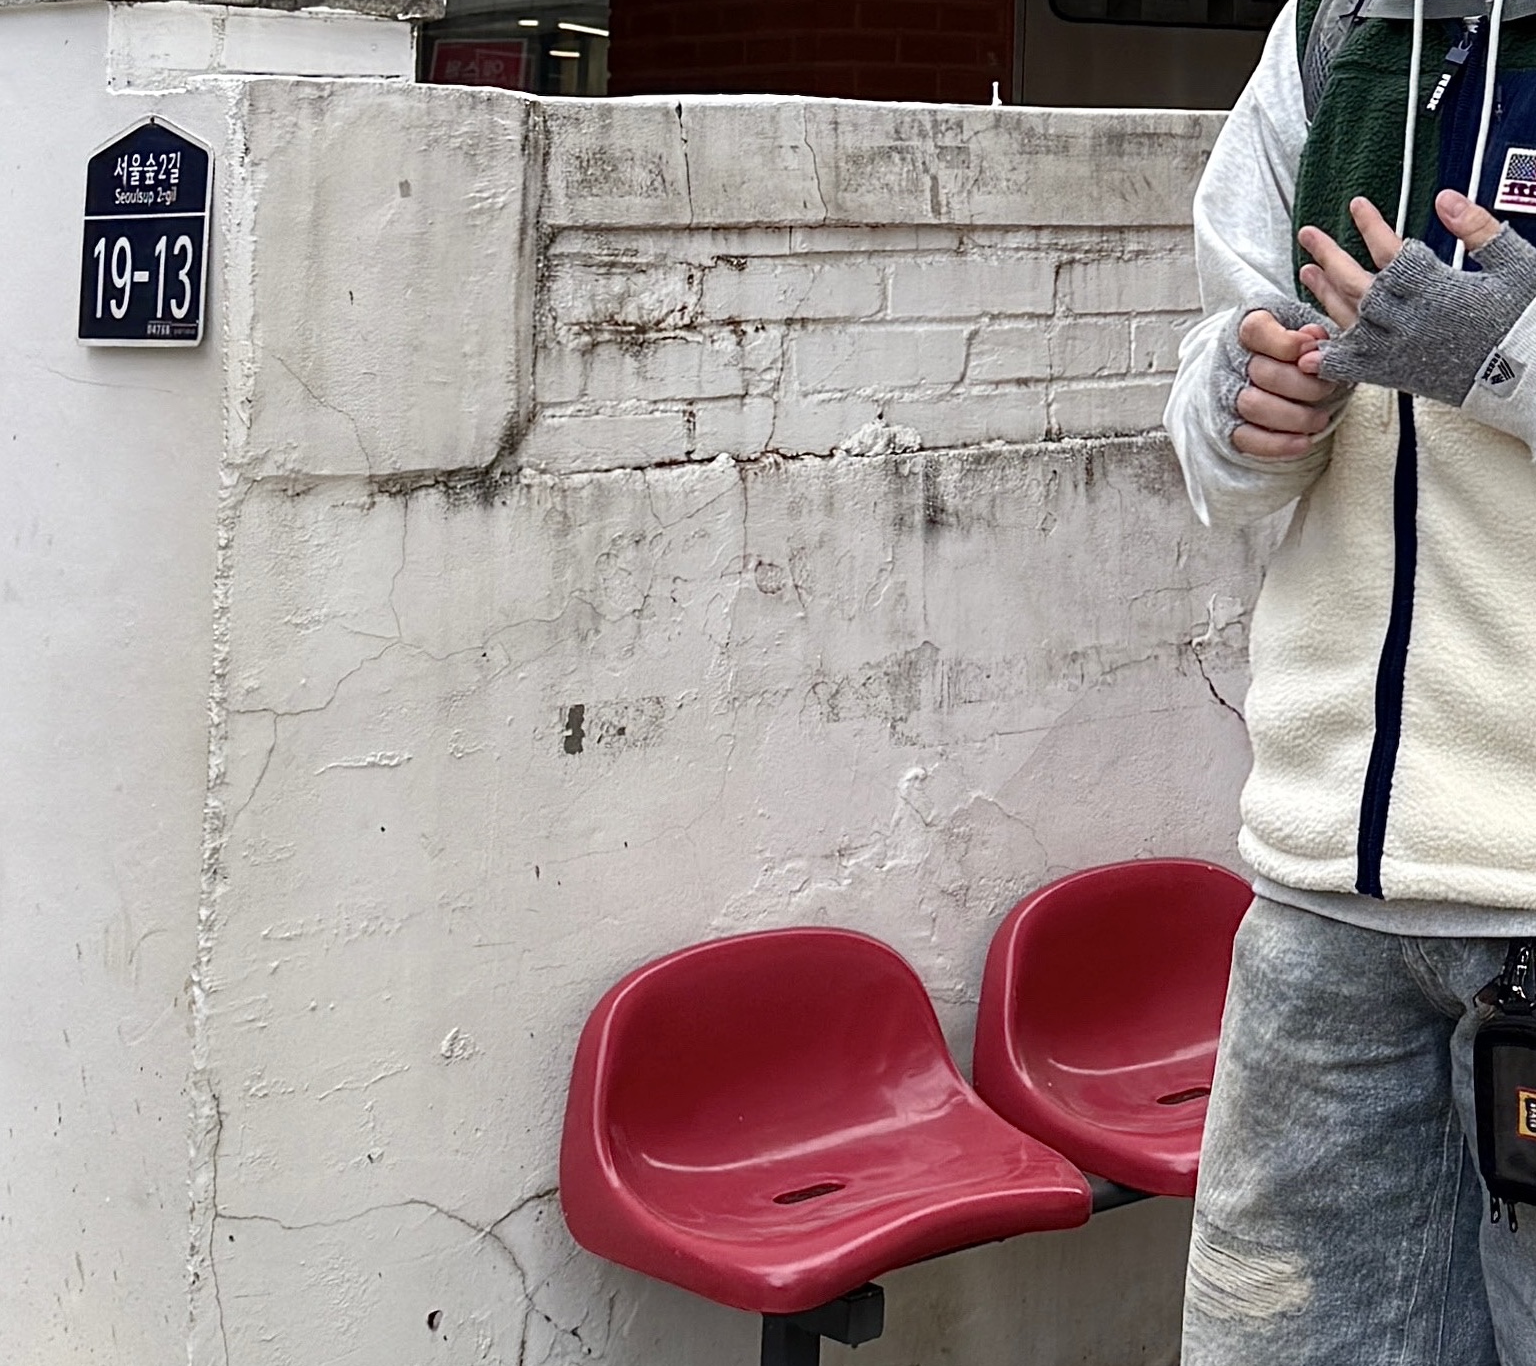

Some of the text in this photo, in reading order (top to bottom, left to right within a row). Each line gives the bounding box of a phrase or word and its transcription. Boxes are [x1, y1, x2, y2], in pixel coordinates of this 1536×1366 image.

[113, 151, 181, 187] 서울숲2길
[115, 187, 155, 207] Seoulsup
[93, 235, 194, 319] 19-13
